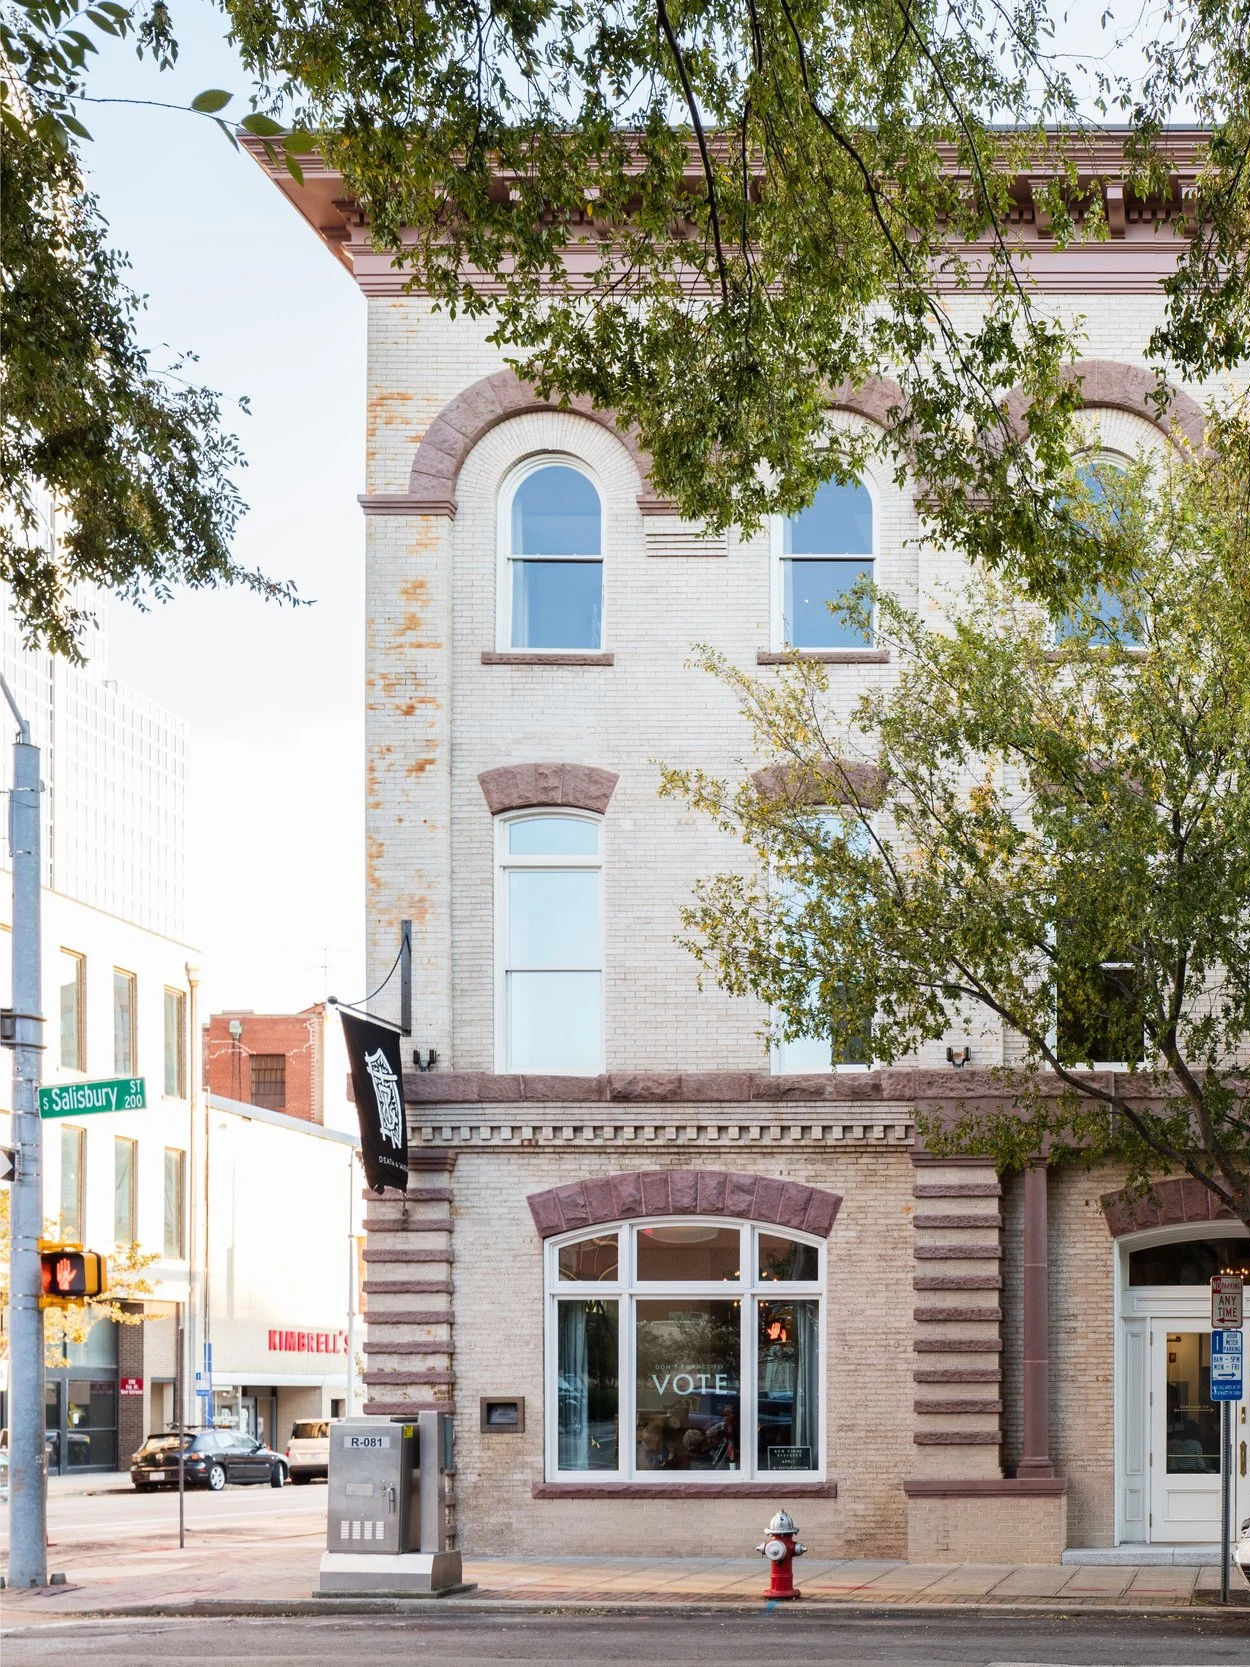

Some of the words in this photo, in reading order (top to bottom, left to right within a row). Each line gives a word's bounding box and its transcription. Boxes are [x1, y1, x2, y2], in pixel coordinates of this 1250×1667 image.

[43, 1097, 49, 1110] S
[51, 1085, 118, 1111] Salisbury
[129, 1080, 141, 1093] ST
[124, 1094, 143, 1108] 200
[1212, 1280, 1221, 1291] NO
[1221, 1282, 1241, 1290] PARKING
[1218, 1295, 1237, 1306] ANY
[1217, 1307, 1238, 1318] TIME
[651, 1373, 728, 1396] VOTE
[351, 1437, 383, 1447] R-081
